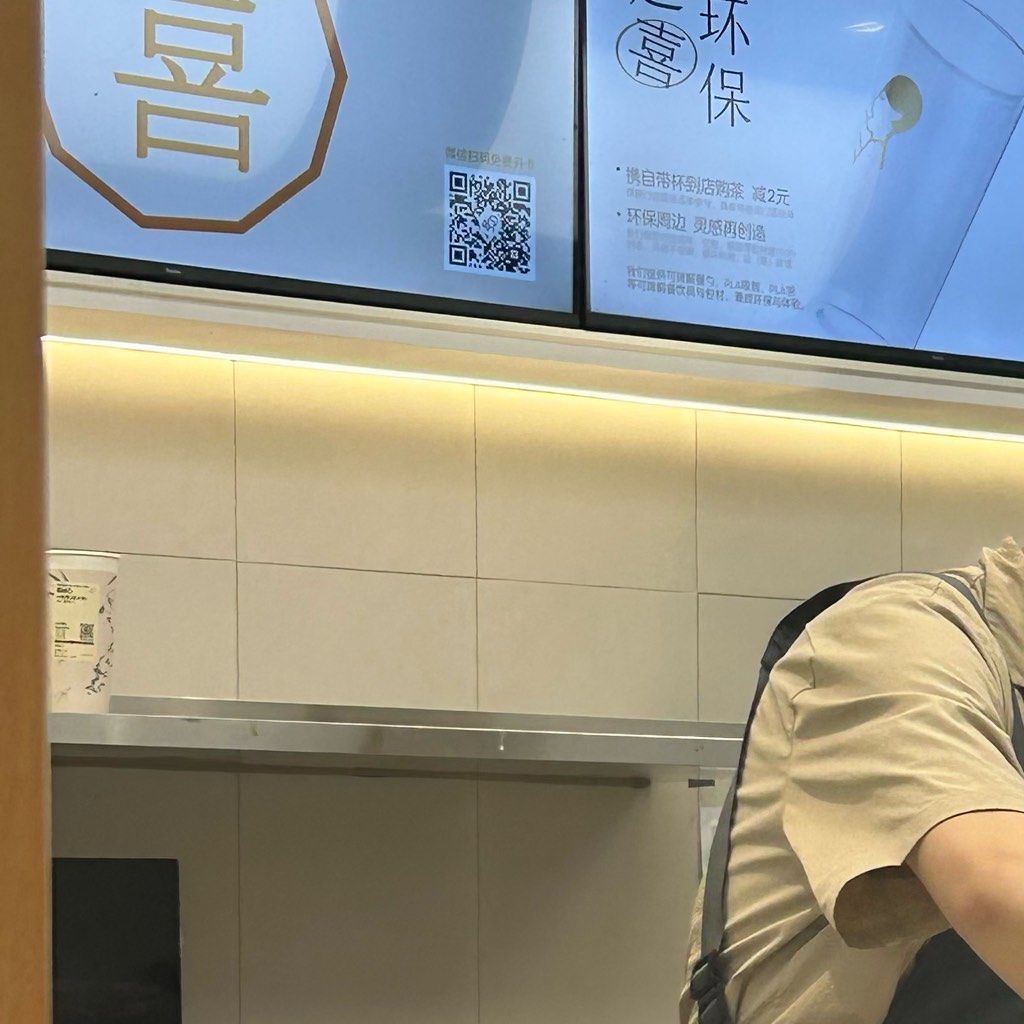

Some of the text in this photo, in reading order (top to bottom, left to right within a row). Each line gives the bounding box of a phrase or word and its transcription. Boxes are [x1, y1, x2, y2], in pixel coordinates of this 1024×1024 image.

[622, 0, 692, 89] 喜
[753, 185, 790, 206] 减2元
[627, 208, 687, 232] 环保周边
